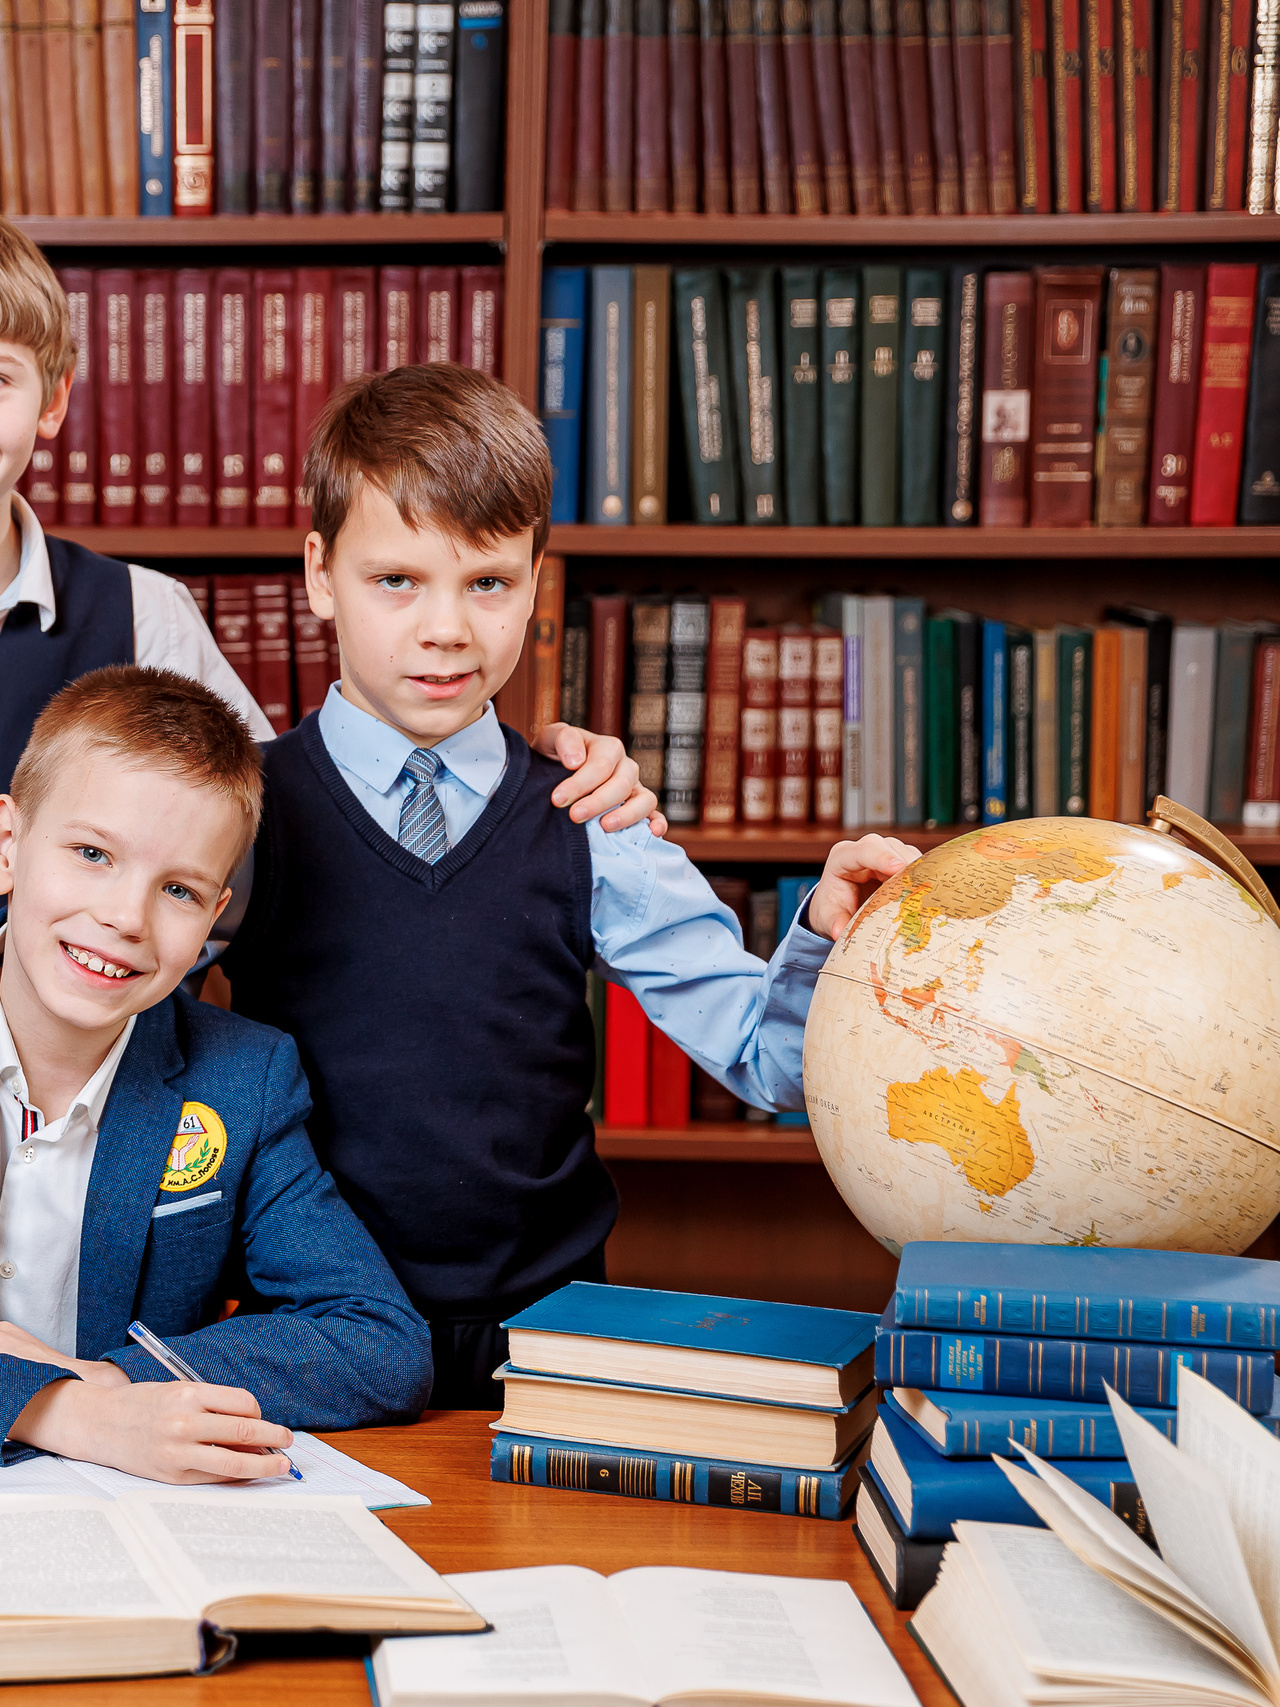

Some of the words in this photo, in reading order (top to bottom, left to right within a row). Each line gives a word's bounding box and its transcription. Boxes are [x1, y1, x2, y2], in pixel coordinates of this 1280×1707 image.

[1199, 1015, 1263, 1052] ТИХИЙ
[820, 1098, 840, 1113] ОКЕАН
[184, 1116, 196, 1129] 61
[923, 1110, 977, 1136] АВСТРАЛИЯ
[730, 1471, 746, 1504] ЧЕХОВ
